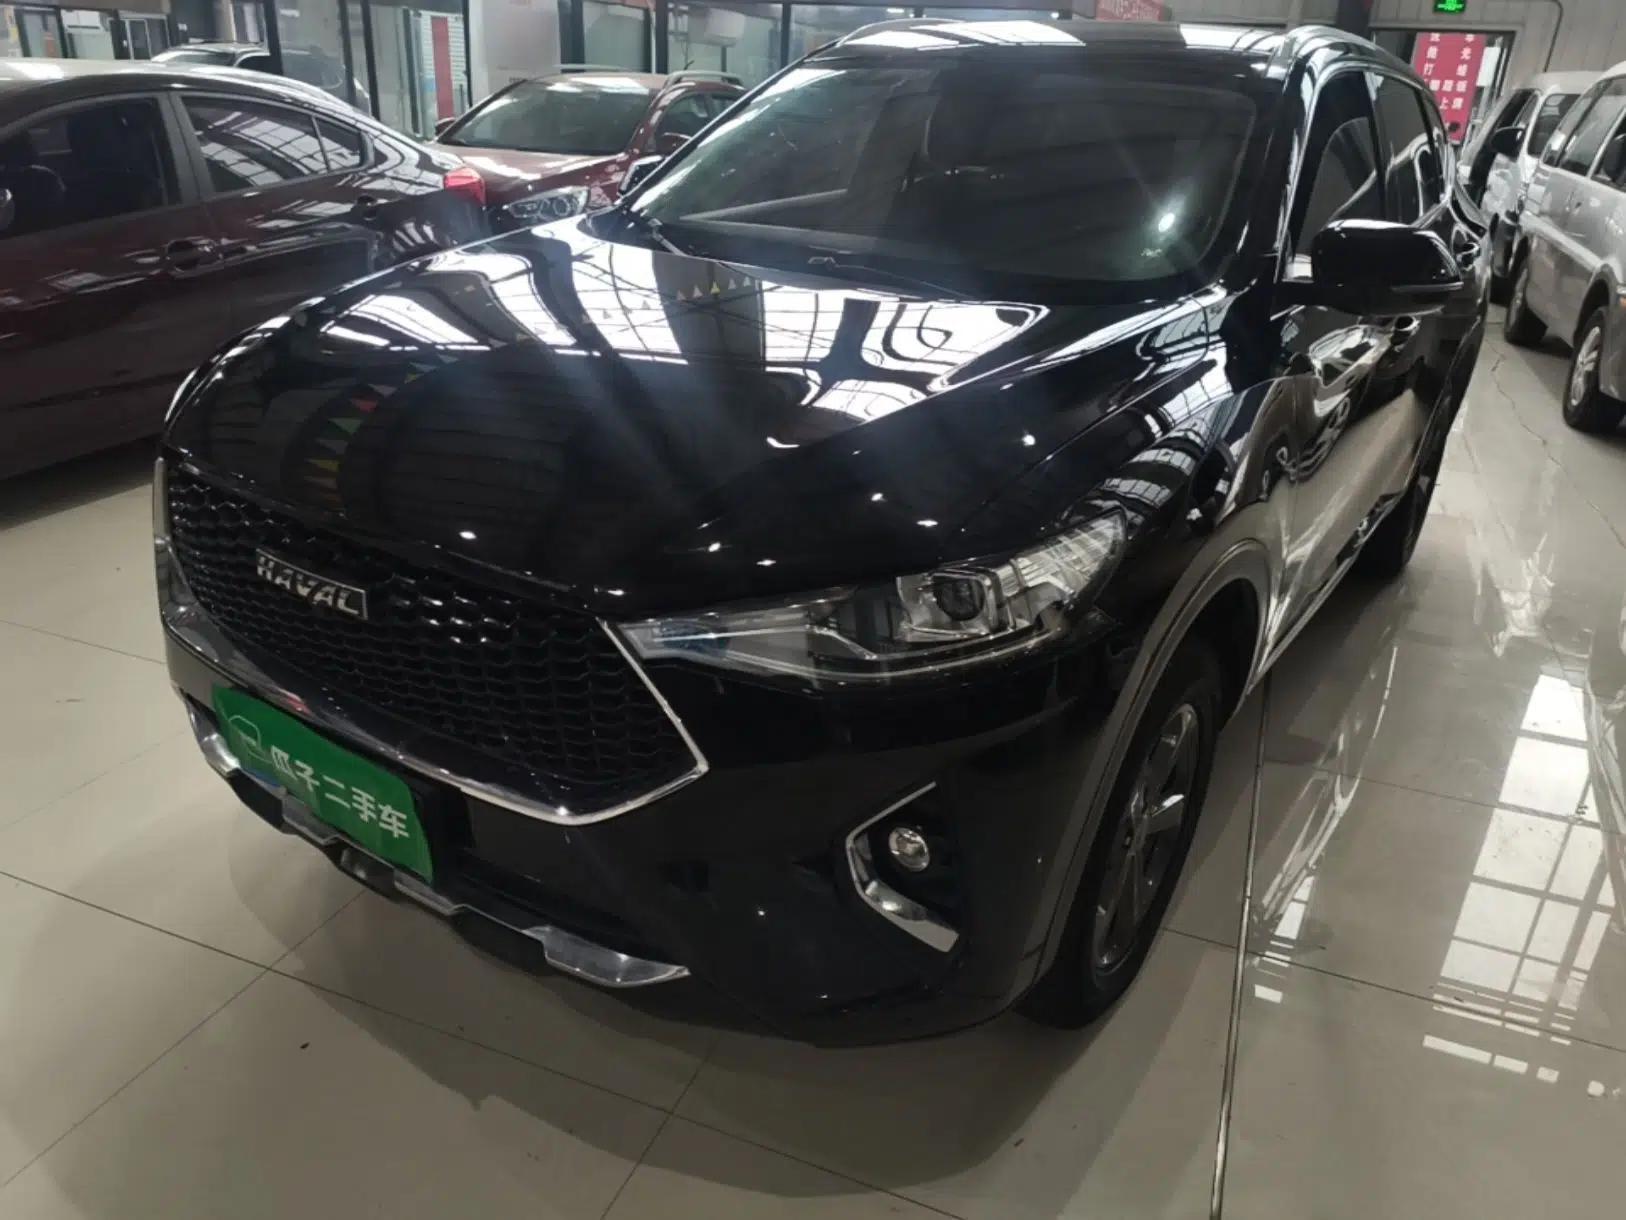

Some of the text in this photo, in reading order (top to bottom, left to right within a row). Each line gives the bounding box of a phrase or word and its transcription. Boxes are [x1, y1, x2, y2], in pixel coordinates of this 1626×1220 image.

[257, 556, 360, 615] HAVAL
[271, 744, 409, 838] 瓜子二手车
